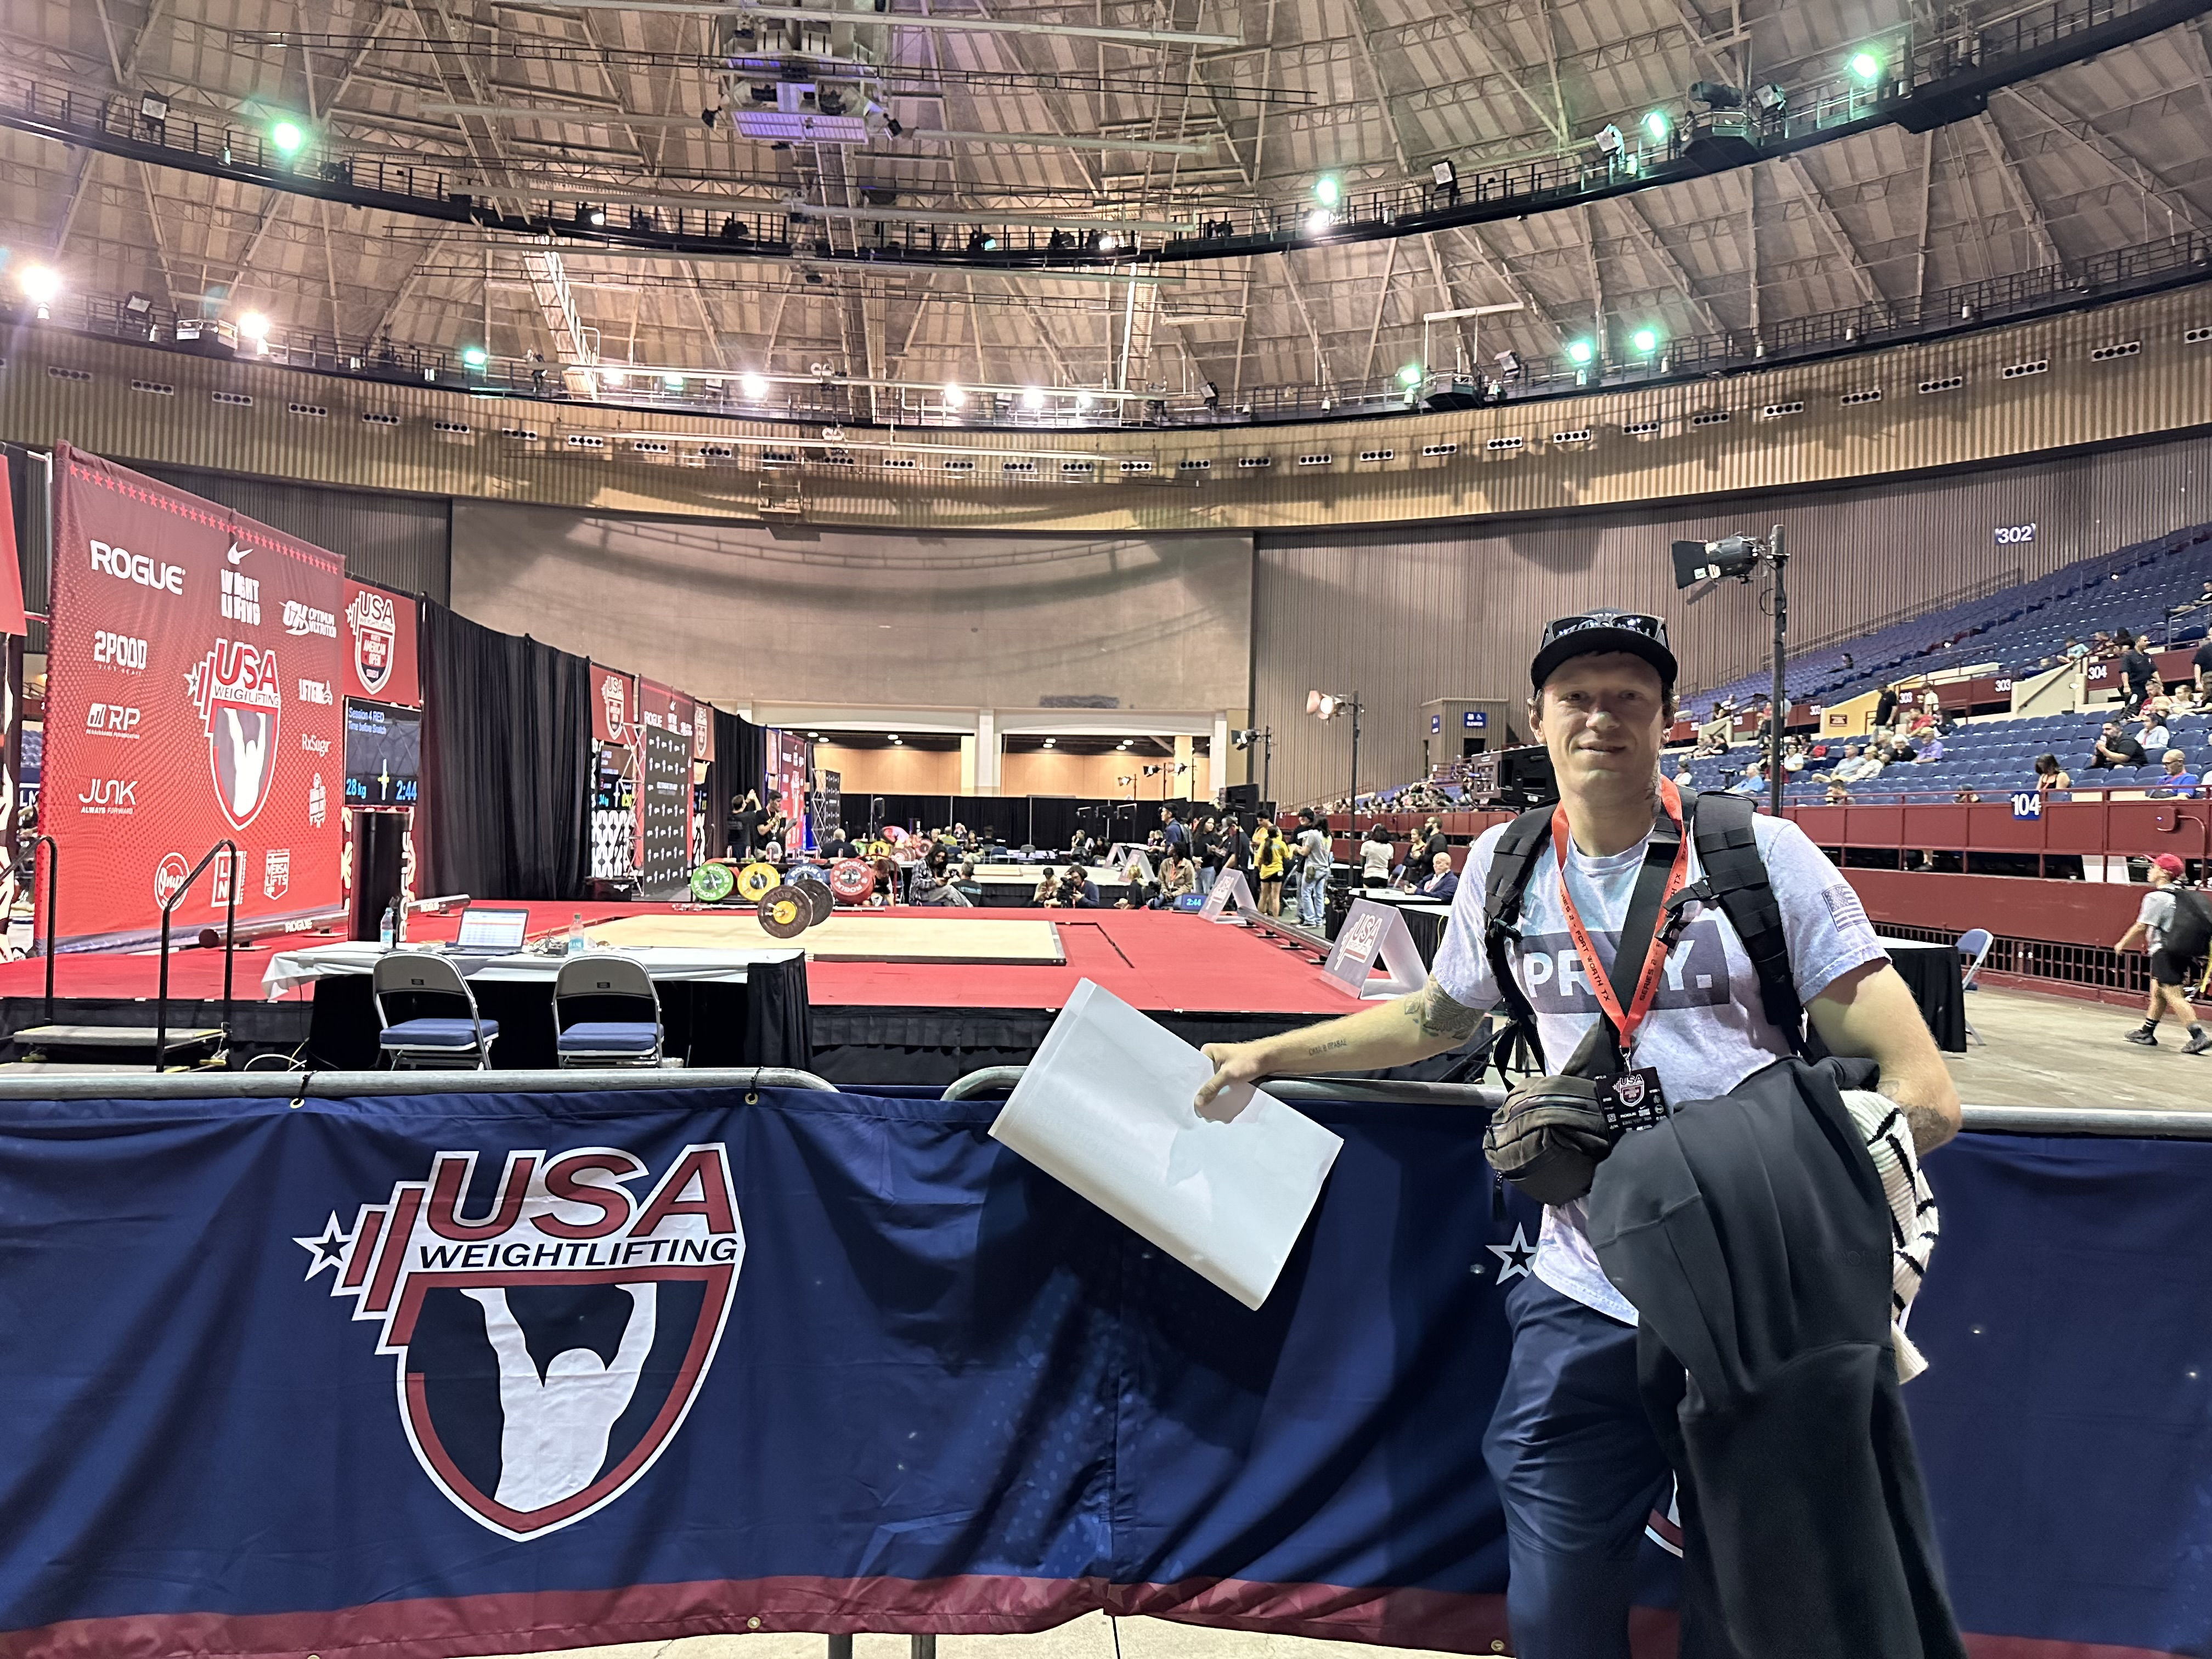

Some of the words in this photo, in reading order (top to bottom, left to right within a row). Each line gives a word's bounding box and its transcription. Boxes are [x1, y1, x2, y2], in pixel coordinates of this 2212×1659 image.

[1997, 526, 2033, 544] 302
[90, 539, 184, 595] ROGUE
[360, 592, 393, 624] USA
[215, 639, 278, 695] USA
[2089, 665, 2107, 680] 304
[1995, 679, 2011, 692] 303
[108, 704, 140, 731] RP
[644, 711, 663, 727] ROGUE
[78, 778, 138, 805] JUNK
[358, 783, 367, 799] kg
[396, 780, 417, 801] 2:44
[2011, 793, 2040, 816] 104
[707, 865, 730, 883] ROGUE
[790, 865, 819, 877] ROGUE
[839, 861, 867, 873] ROGUE
[1186, 898, 1201, 906] 2:44
[285, 919, 313, 933] ROGUE
[1352, 916, 1382, 946] USA
[1523, 940, 1713, 998] PRY.
[1576, 930, 1589, 952] FORT
[1587, 955, 1604, 986] WORTH
[1600, 990, 1611, 1002] TX
[1639, 968, 1654, 1001] SERIES
[1620, 1075, 1643, 1085] USA
[426, 1148, 738, 1241] USA
[419, 1238, 738, 1268] WEIGHTLIFTING
